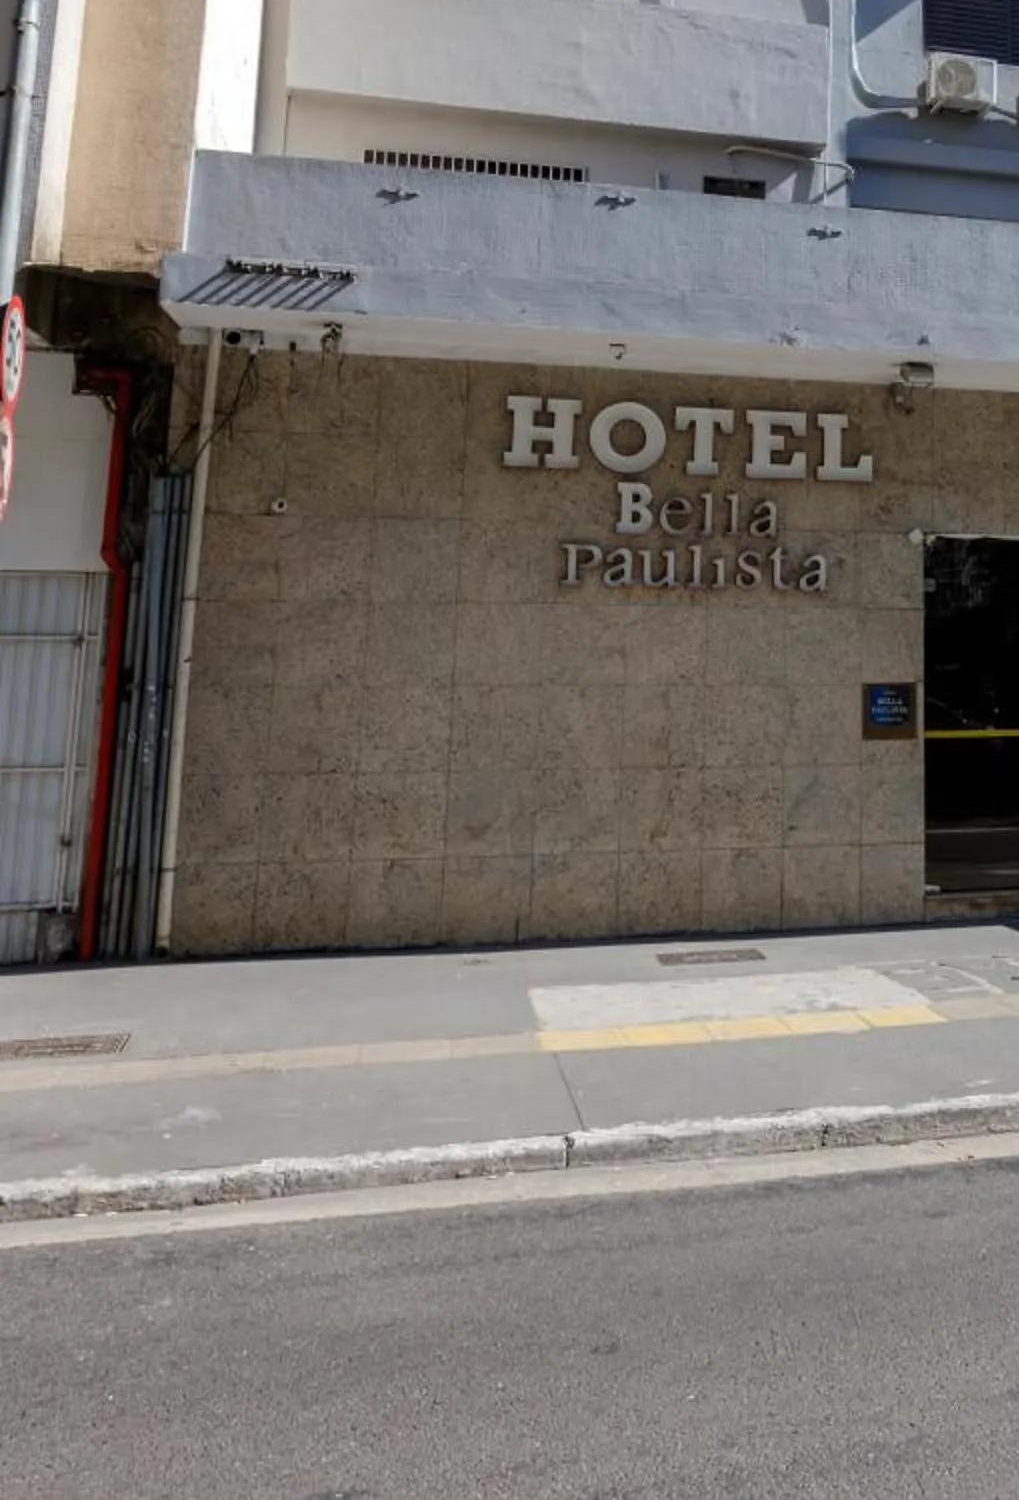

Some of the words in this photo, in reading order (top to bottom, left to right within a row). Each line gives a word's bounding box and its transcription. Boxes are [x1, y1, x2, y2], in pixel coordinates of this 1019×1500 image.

[503, 395, 873, 482] HOTEL
[615, 481, 778, 538] Bella
[560, 542, 828, 592] Paulista
